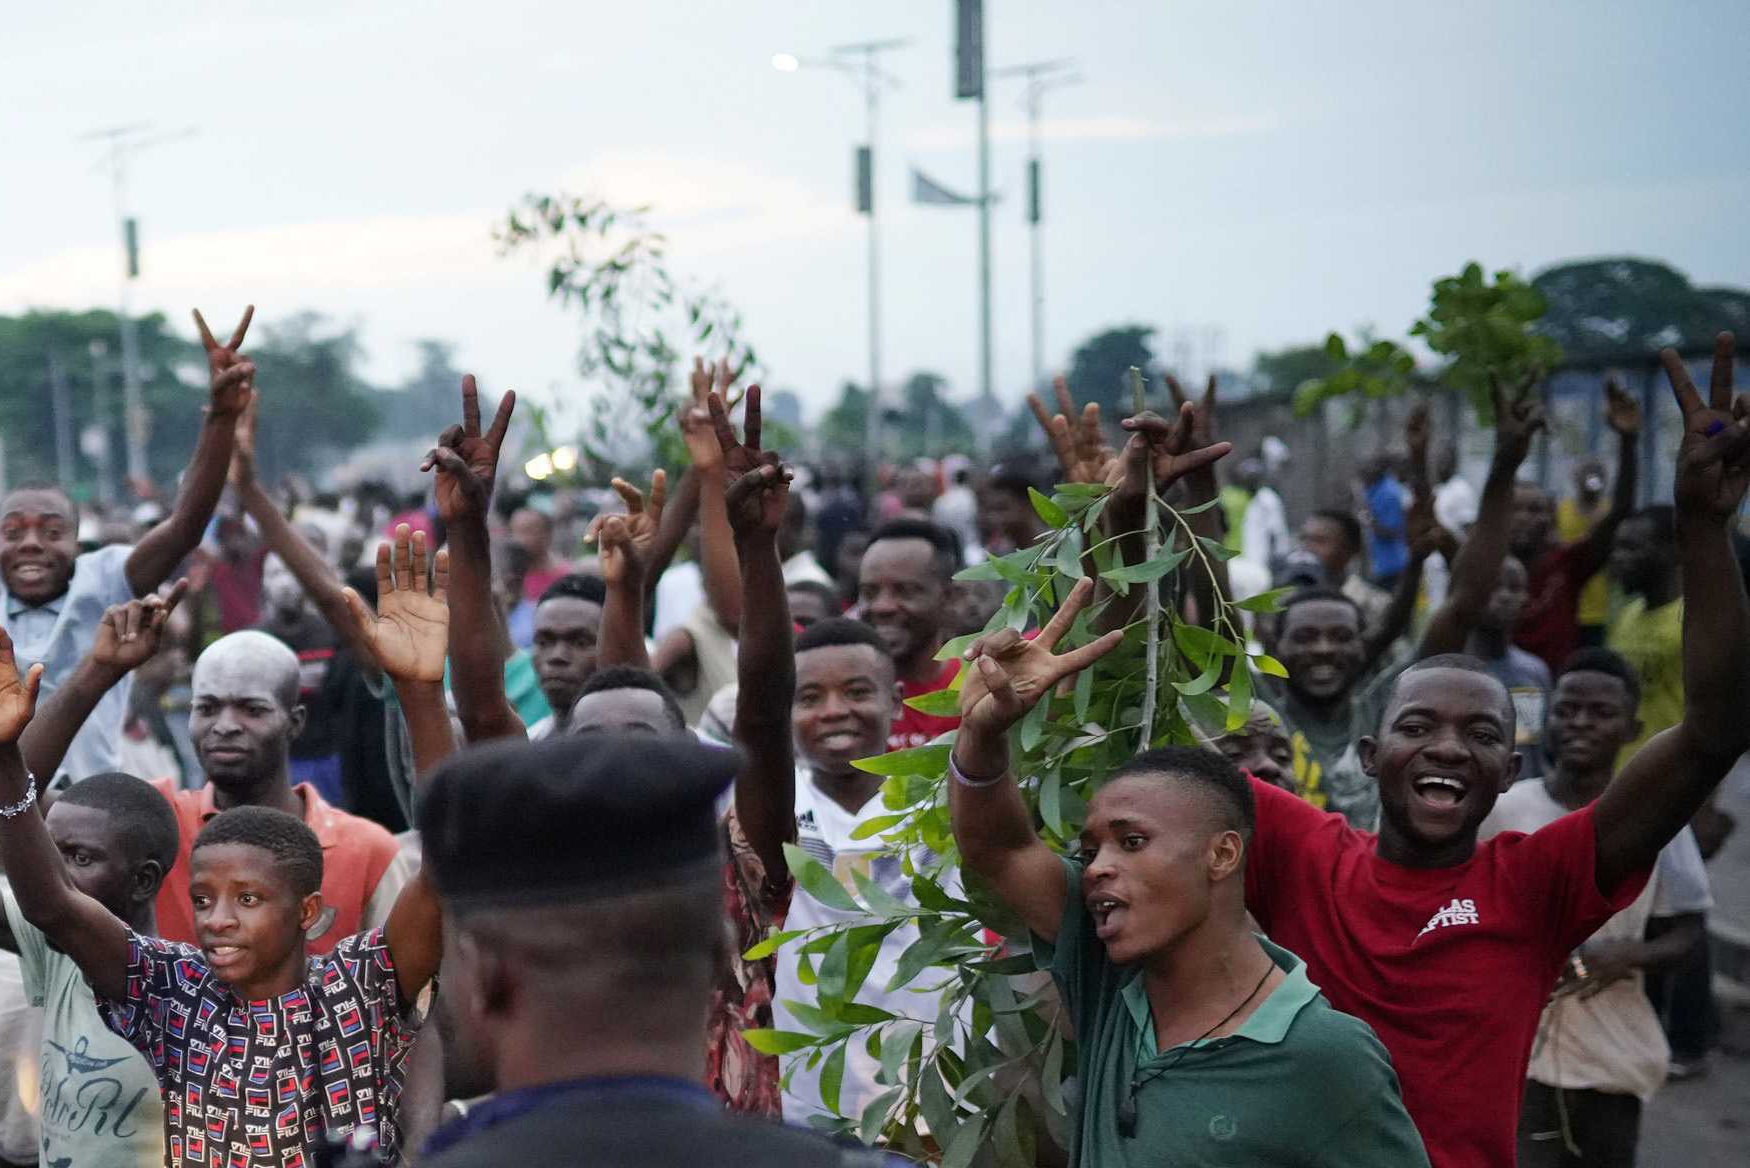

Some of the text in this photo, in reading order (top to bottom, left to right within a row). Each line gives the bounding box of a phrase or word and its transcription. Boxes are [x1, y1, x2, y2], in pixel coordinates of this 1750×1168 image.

[322, 982, 347, 997] FILA
[333, 997, 358, 1013] FILA
[293, 1013, 312, 1024] FILA
[193, 1019, 208, 1032] FIL
[255, 1036, 277, 1047] FILA
[297, 1034, 312, 1044] ILA
[318, 1037, 337, 1051] FILA
[277, 1047, 291, 1058] ILA
[276, 1066, 296, 1078] FILA
[352, 1066, 372, 1080] FILA
[186, 1106, 203, 1118] FILA
[207, 1105, 229, 1119] FILA
[245, 1108, 270, 1117] FILA
[331, 1104, 351, 1118] FILA
[187, 1126, 204, 1138] FILA
[245, 1124, 269, 1134] FILA
[277, 1126, 299, 1139] FILA
[231, 1141, 251, 1155] FILA
[281, 1142, 302, 1157] FILA
